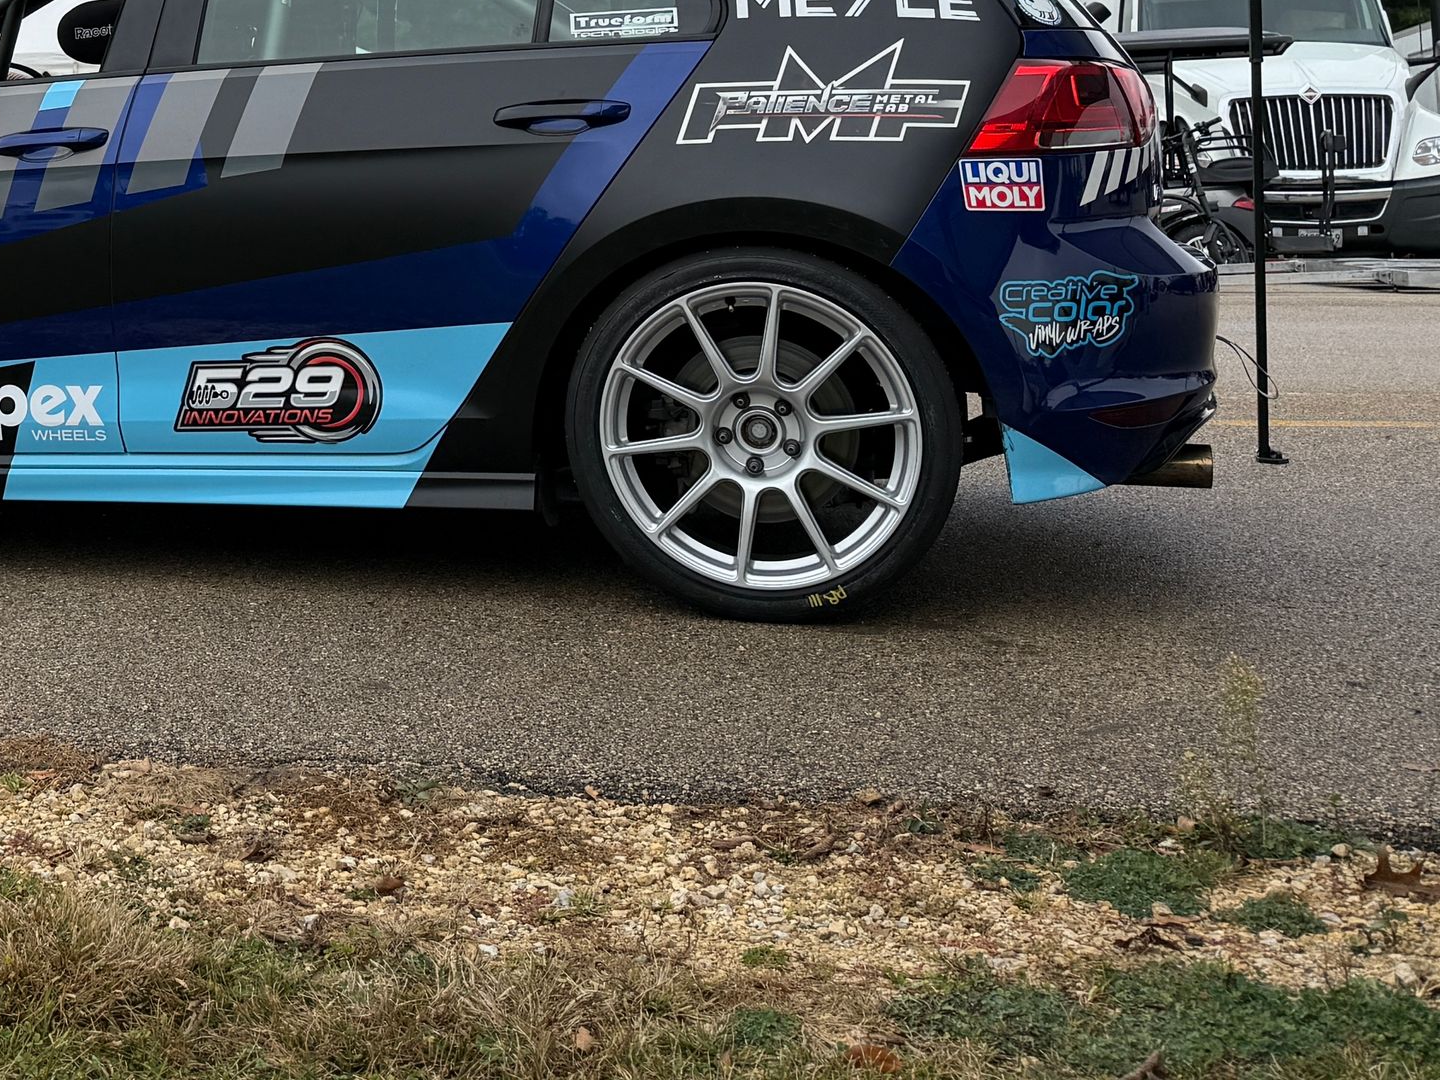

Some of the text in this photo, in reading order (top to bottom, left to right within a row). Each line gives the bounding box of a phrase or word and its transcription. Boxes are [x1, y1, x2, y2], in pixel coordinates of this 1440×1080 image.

[872, 103, 909, 113] FAB
[875, 94, 938, 104] METAL
[964, 161, 1038, 184] LIQUI
[967, 185, 1040, 208] MOLY
[1005, 282, 1118, 301] creative
[1028, 293, 1126, 322] color
[187, 366, 346, 409] 529
[184, 408, 334, 425] INNOVATIONS
[31, 429, 107, 441] WHEELS
